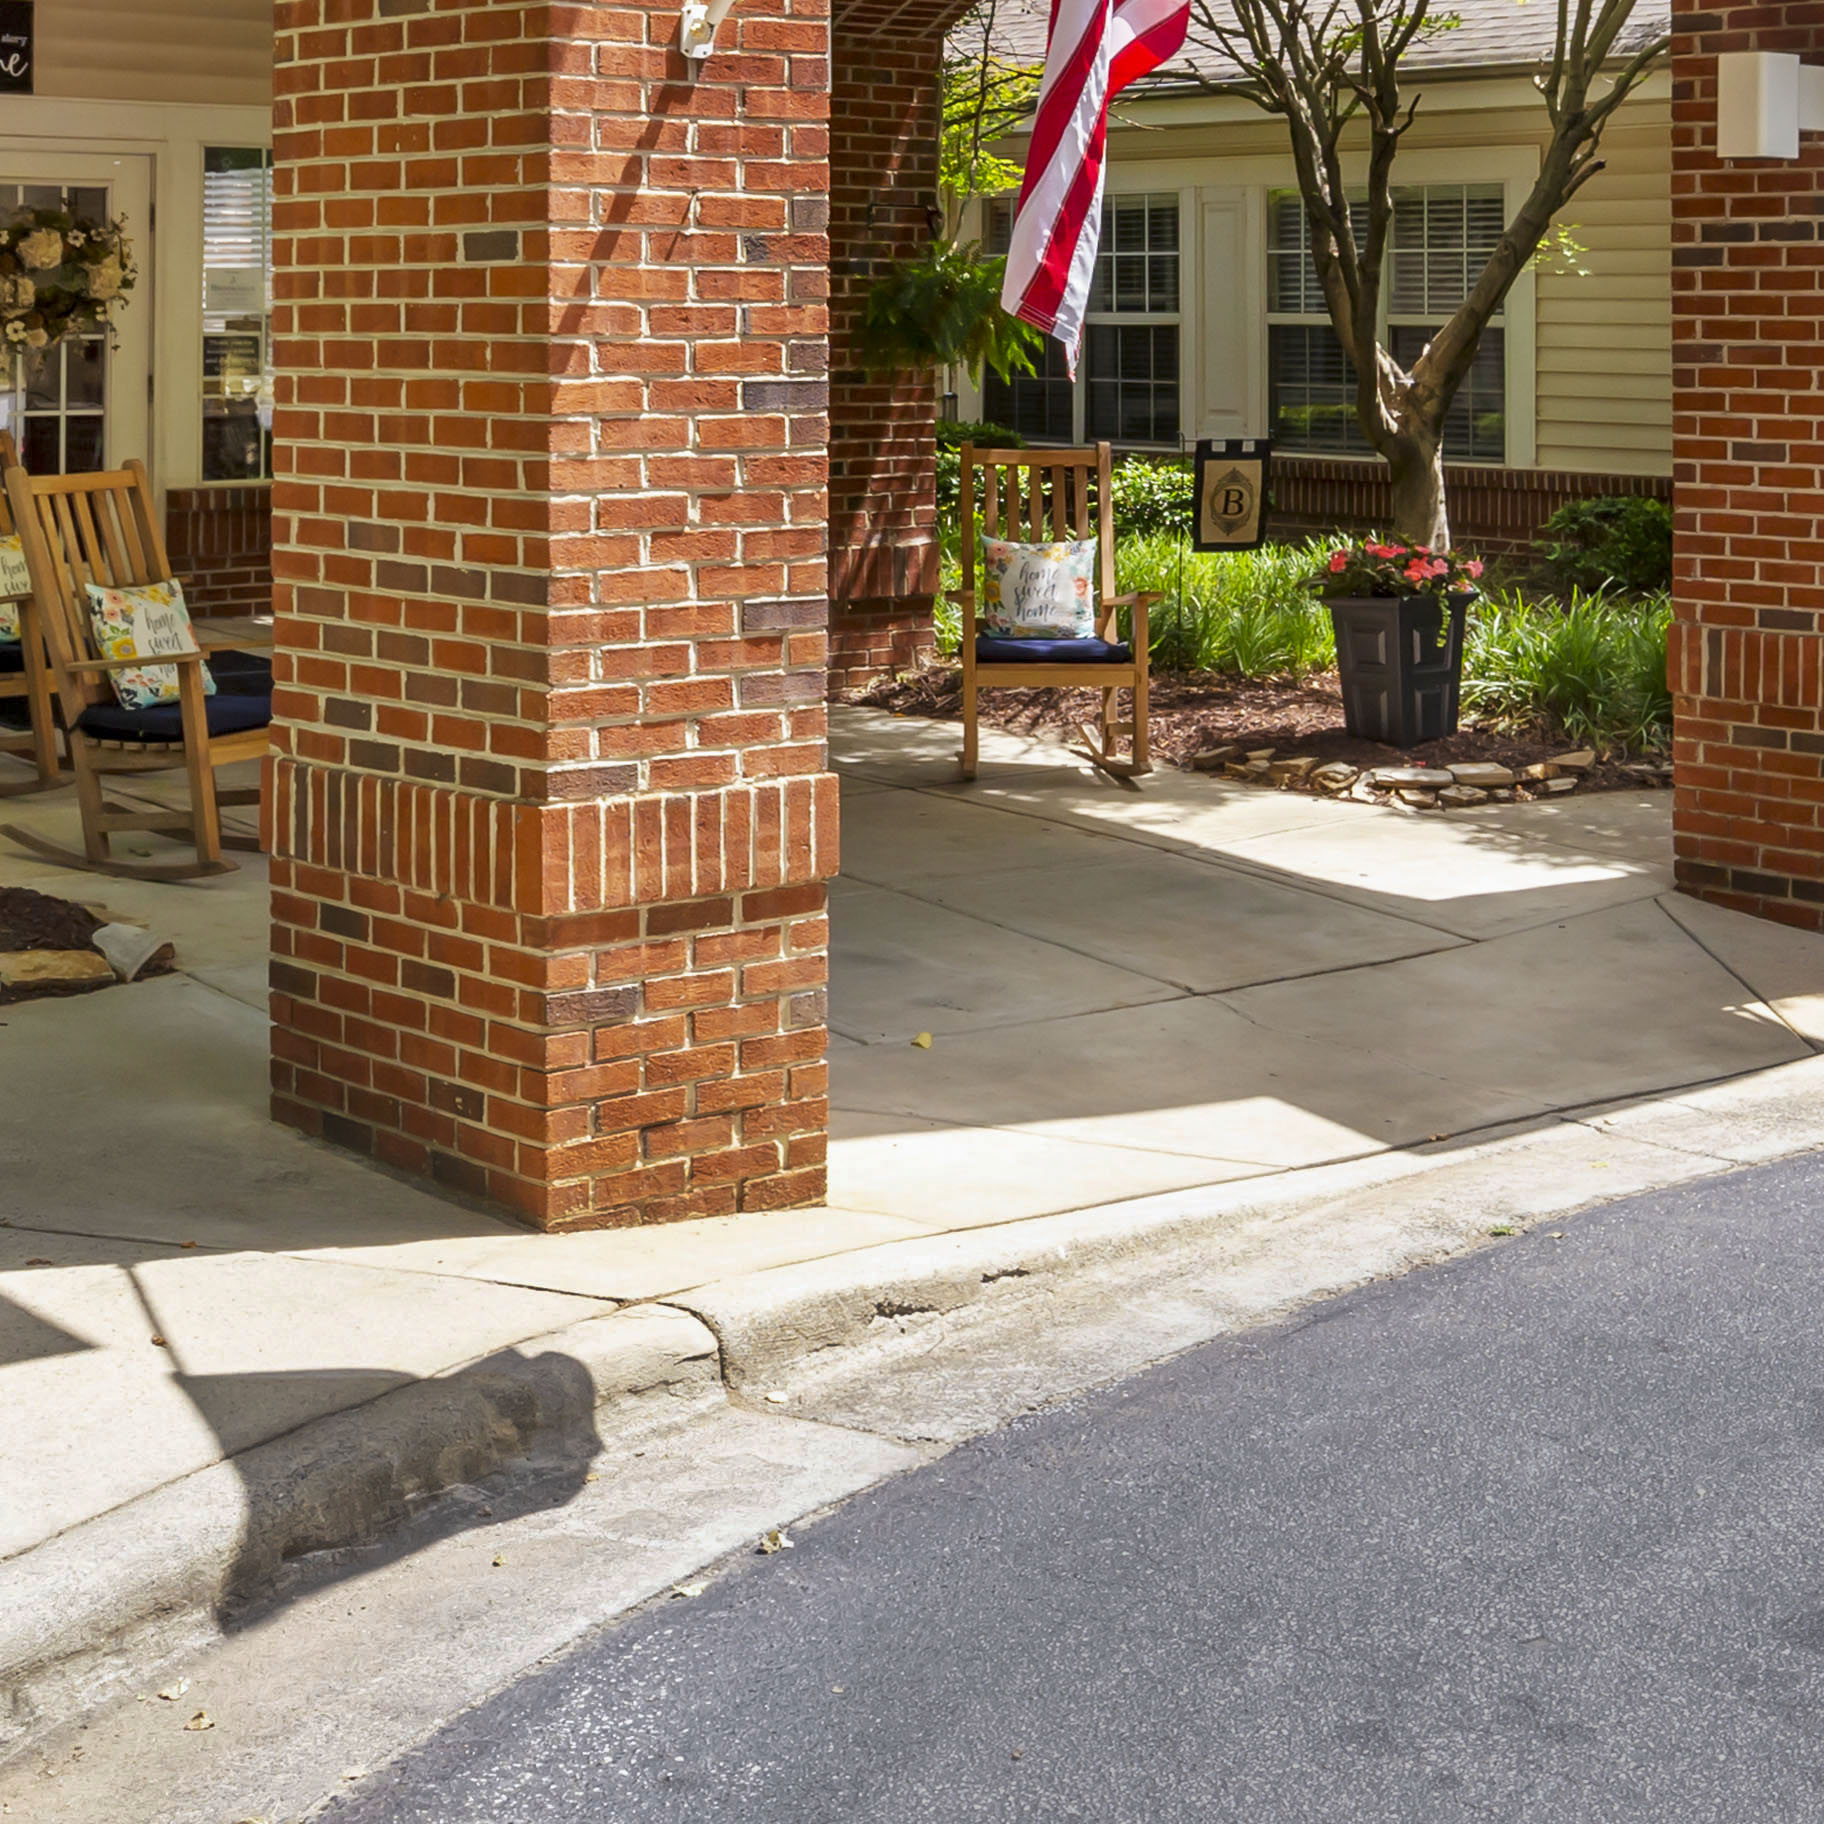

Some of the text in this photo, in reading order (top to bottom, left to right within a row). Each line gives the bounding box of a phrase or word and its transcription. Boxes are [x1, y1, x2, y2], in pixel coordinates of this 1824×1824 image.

[1, 34, 28, 46] story
[1221, 489, 1244, 516] B
[1020, 561, 1060, 584] home
[1014, 583, 1056, 601] sweet
[144, 607, 175, 634] home
[1015, 596, 1057, 622] home
